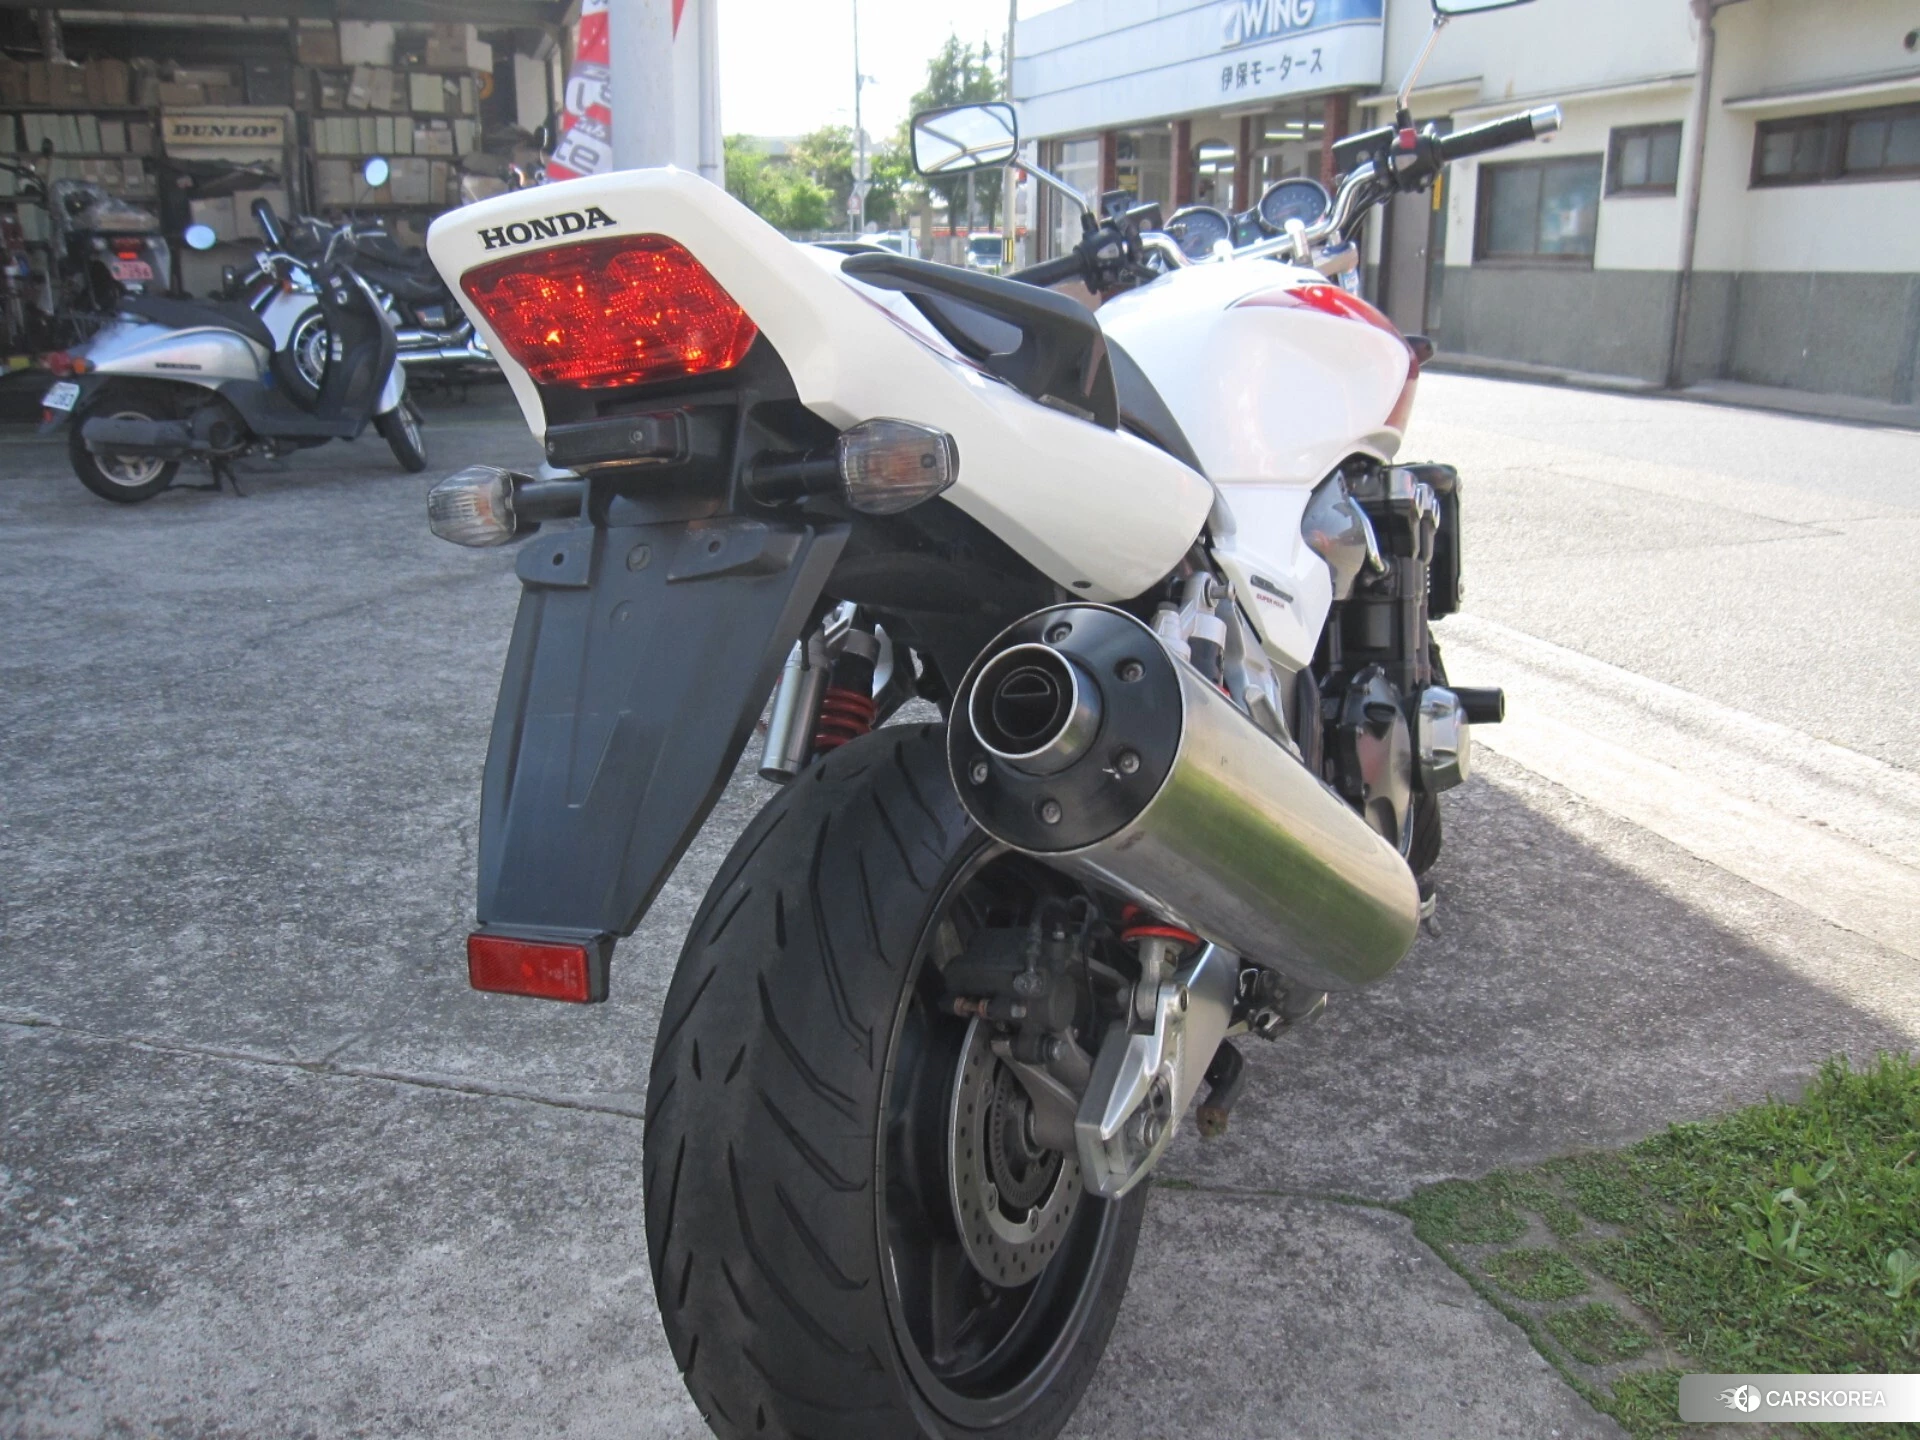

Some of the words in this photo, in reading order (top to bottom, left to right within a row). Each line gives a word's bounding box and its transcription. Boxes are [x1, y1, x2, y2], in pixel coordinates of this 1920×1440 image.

[1241, 0, 1316, 38] WING
[1221, 47, 1323, 91] 伊保モータース
[173, 123, 277, 138] DUNLOP
[477, 206, 617, 250] HONDA
